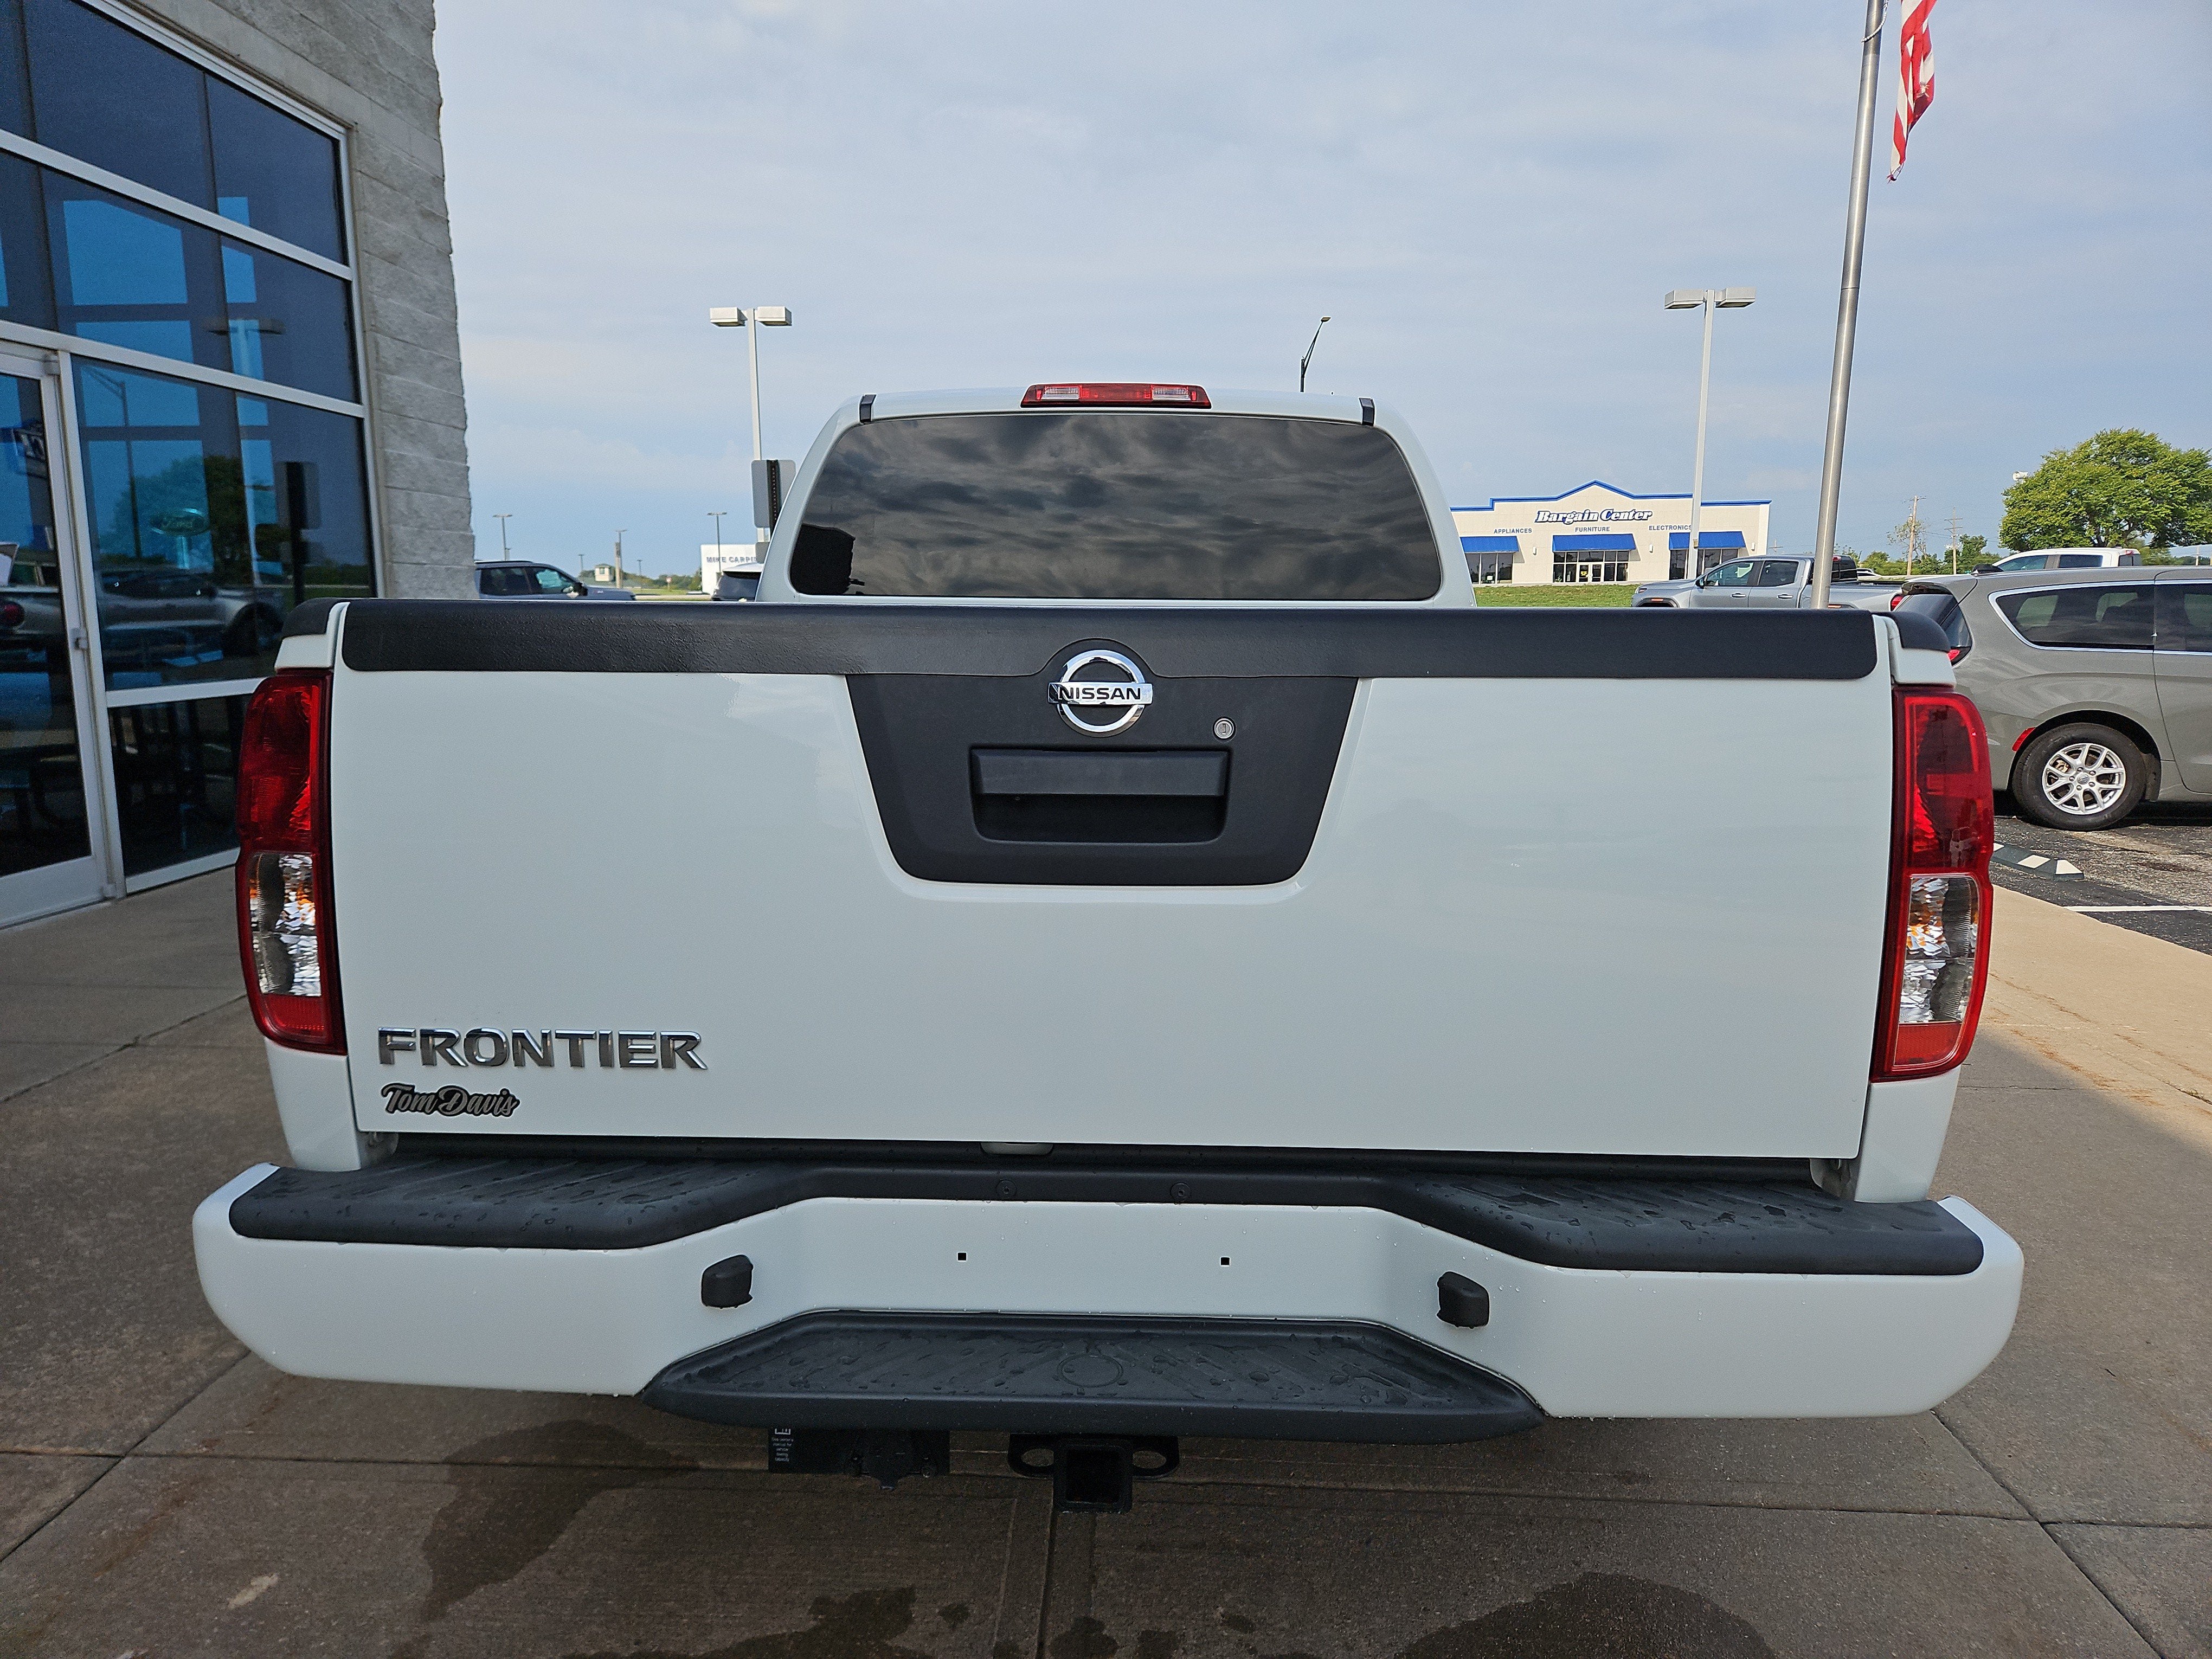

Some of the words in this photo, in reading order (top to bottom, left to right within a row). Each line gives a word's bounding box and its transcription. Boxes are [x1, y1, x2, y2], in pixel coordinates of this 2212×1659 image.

[1534, 509, 1599, 525] Bargain
[1600, 509, 1652, 521] Center
[1059, 687, 1141, 700] NISSAN
[378, 1027, 708, 1070] FRONTIER
